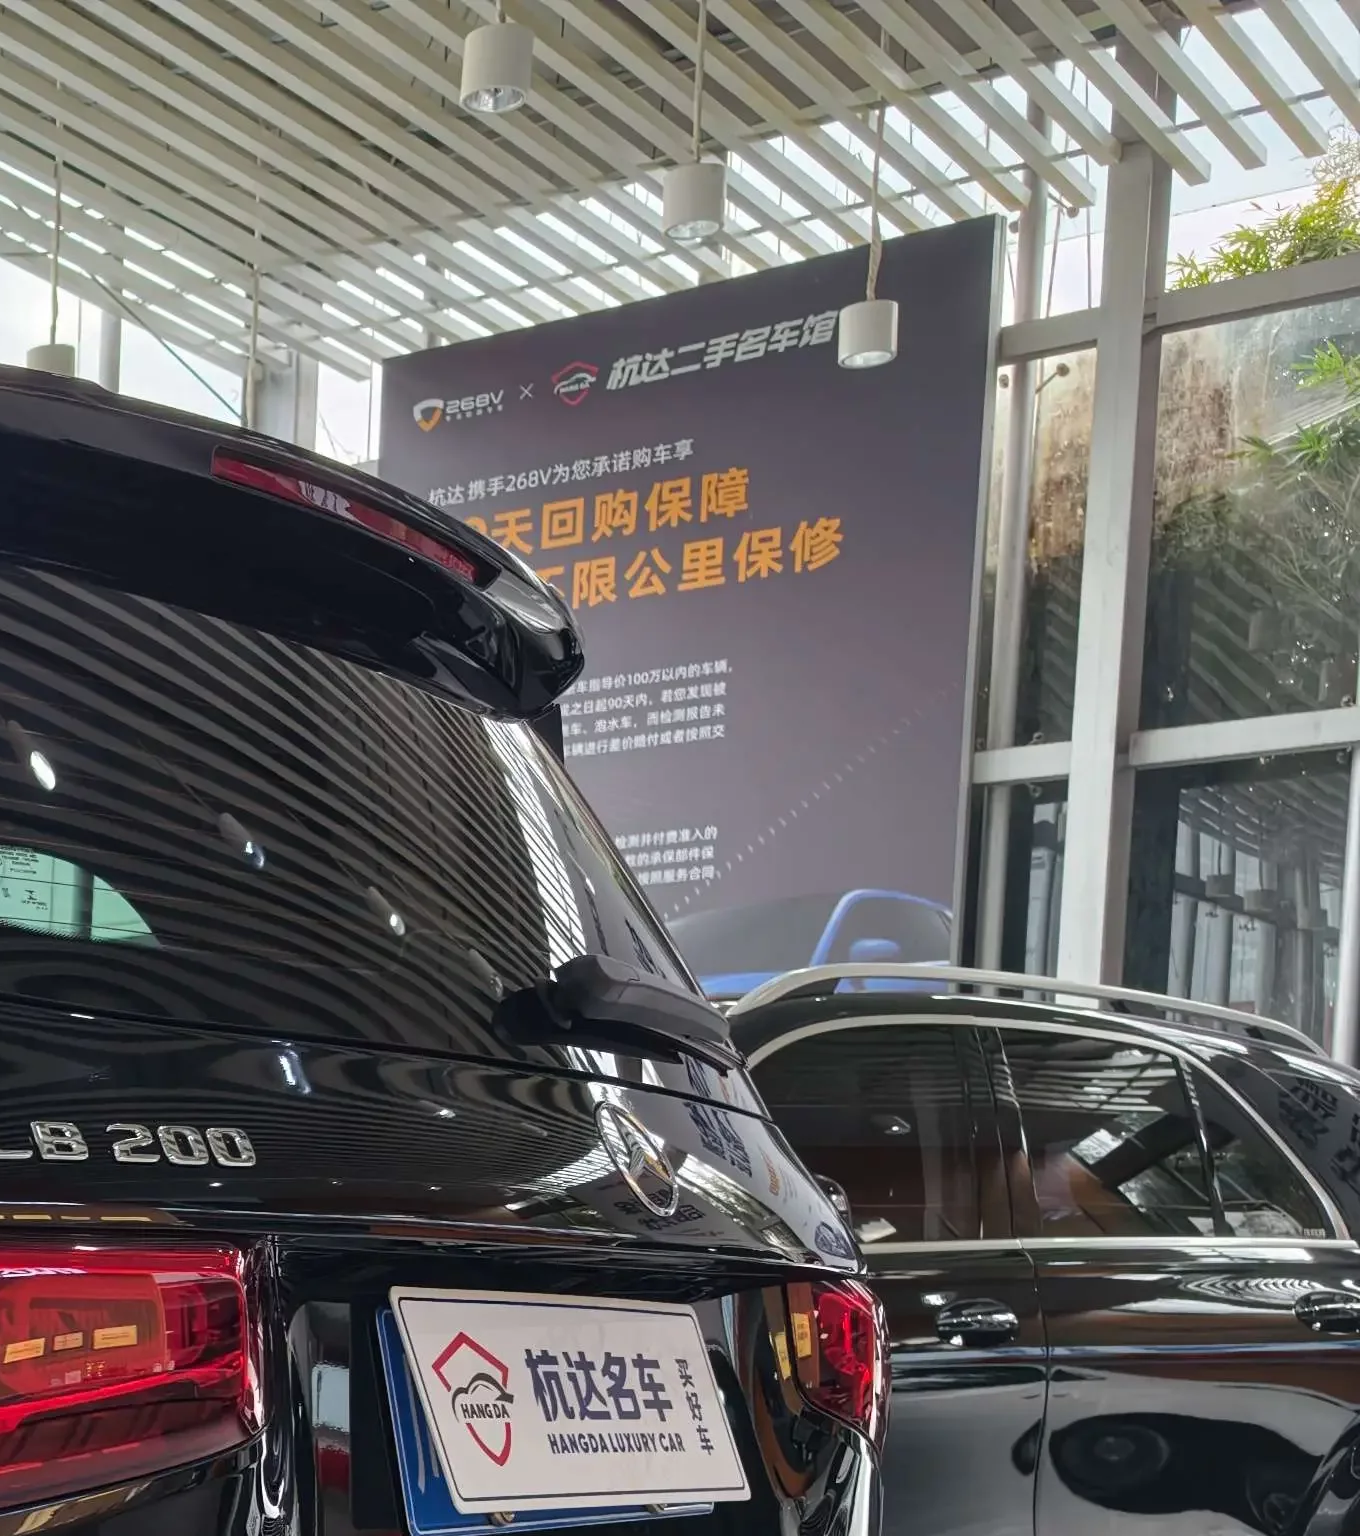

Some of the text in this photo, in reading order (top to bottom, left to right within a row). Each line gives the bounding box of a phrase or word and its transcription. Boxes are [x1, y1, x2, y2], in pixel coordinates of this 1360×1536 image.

[606, 310, 840, 392] 杭达二手名车馆
[106, 1123, 256, 1167] 200
[525, 1348, 673, 1422] 杭达名车
[461, 1403, 511, 1419] HANG DA
[547, 1432, 686, 1455] HANGDA LUXURY CAR
